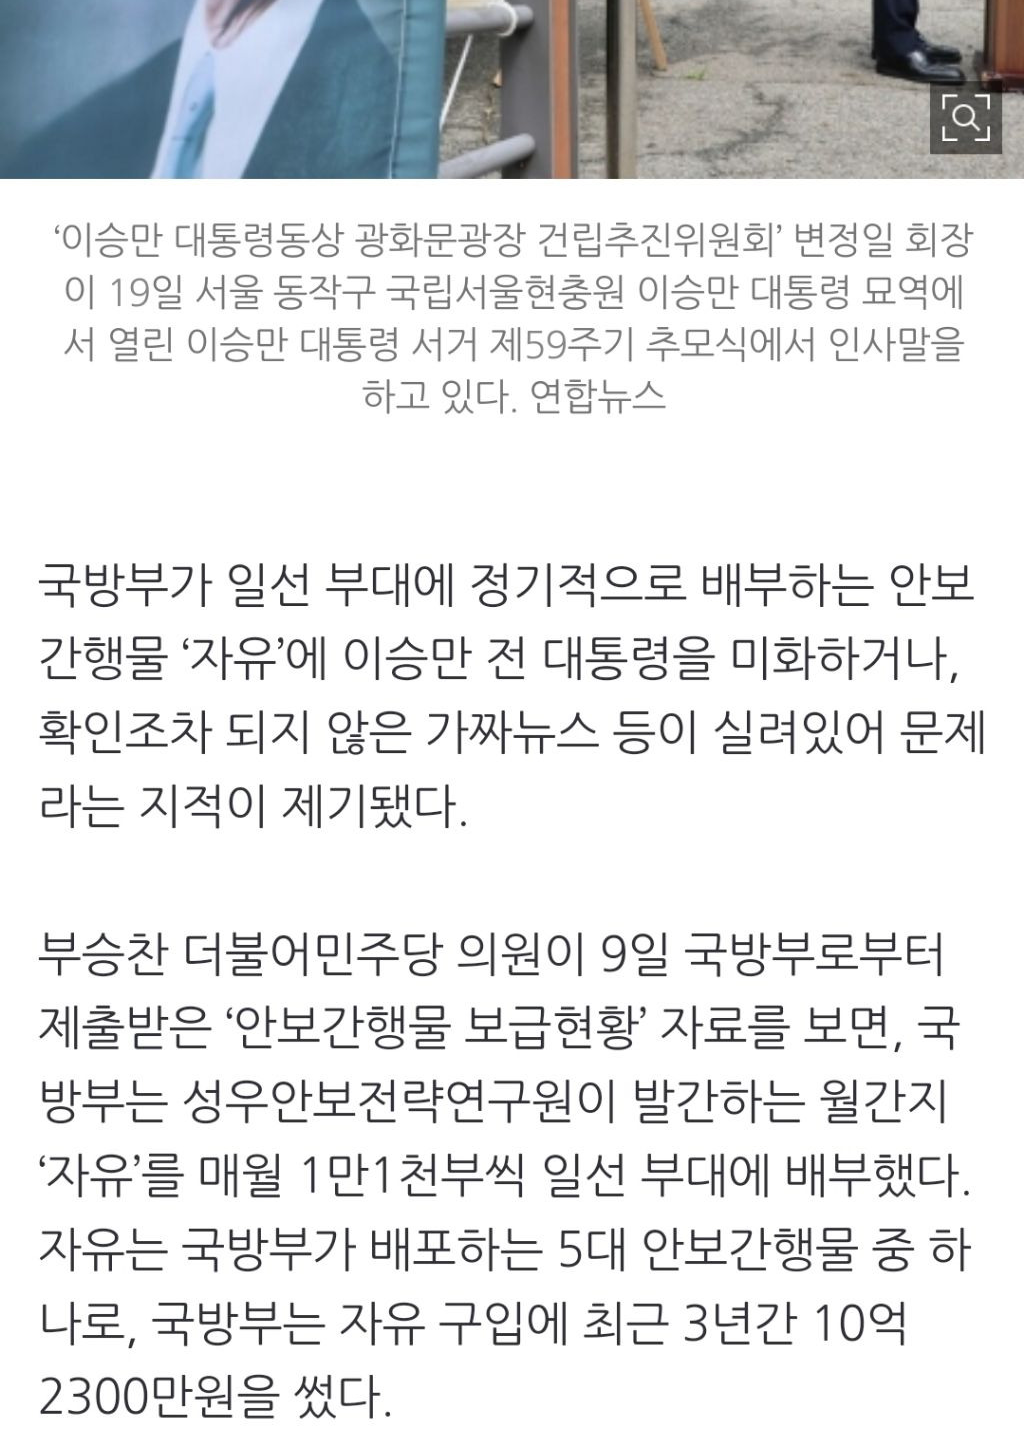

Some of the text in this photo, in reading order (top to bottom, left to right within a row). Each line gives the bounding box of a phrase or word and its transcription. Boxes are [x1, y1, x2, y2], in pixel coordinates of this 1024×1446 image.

[175, 221, 345, 259] 대통령동상
[354, 221, 527, 259] 광화문광장
[795, 221, 892, 259] 변정일
[905, 221, 975, 259] 회장
[65, 273, 963, 311] 이 19일 서울 동작구 국립서울현충원 이승만 대통령 묘역에
[63, 326, 965, 363] 서 열린 이승만 대통령 서거 제59주기 추모식에서 인사말을
[361, 378, 667, 415] 하고 있다. 연합뉴스
[38, 562, 975, 609] 국방부가 일선 부대에 정기적으로 배부하는 안보
[40, 635, 169, 681] 간행물
[344, 635, 473, 682] 이승만
[487, 635, 525, 680] 전
[544, 635, 716, 682] 대통령을
[732, 635, 958, 684] 미화하거나,
[38, 709, 985, 756] 확인조차 되지 않은 가짜뉴스 등이 실려있어 문제
[41, 783, 467, 830] 라는 지적이 제기됐다.
[38, 931, 942, 978] 부승찬 더불어민주당 의원이 9일 국방부로부터
[38, 1004, 213, 1051] 제출받은
[660, 1004, 791, 1051] 자료를
[803, 1004, 902, 1053] 보면,
[917, 1005, 961, 1051] 국
[41, 1078, 945, 1125] 방부는 성우안보전략연구원이 발간하는 월간지
[199, 1152, 281, 1199] 매월
[303, 1152, 523, 1199] 1만1천부씩
[543, 1152, 625, 1199] 일선
[640, 1152, 769, 1199] 부대에
[786, 1152, 970, 1199] 배부했다.
[39, 1226, 972, 1274] 자유는 국방부가 배포하는 5대 안보간행물 중 하
[41, 1300, 905, 1350] 나로, 국방부는 자유 구입에 최근 3년간 10억
[39, 1373, 391, 1420] 2300만원을 썼다.
